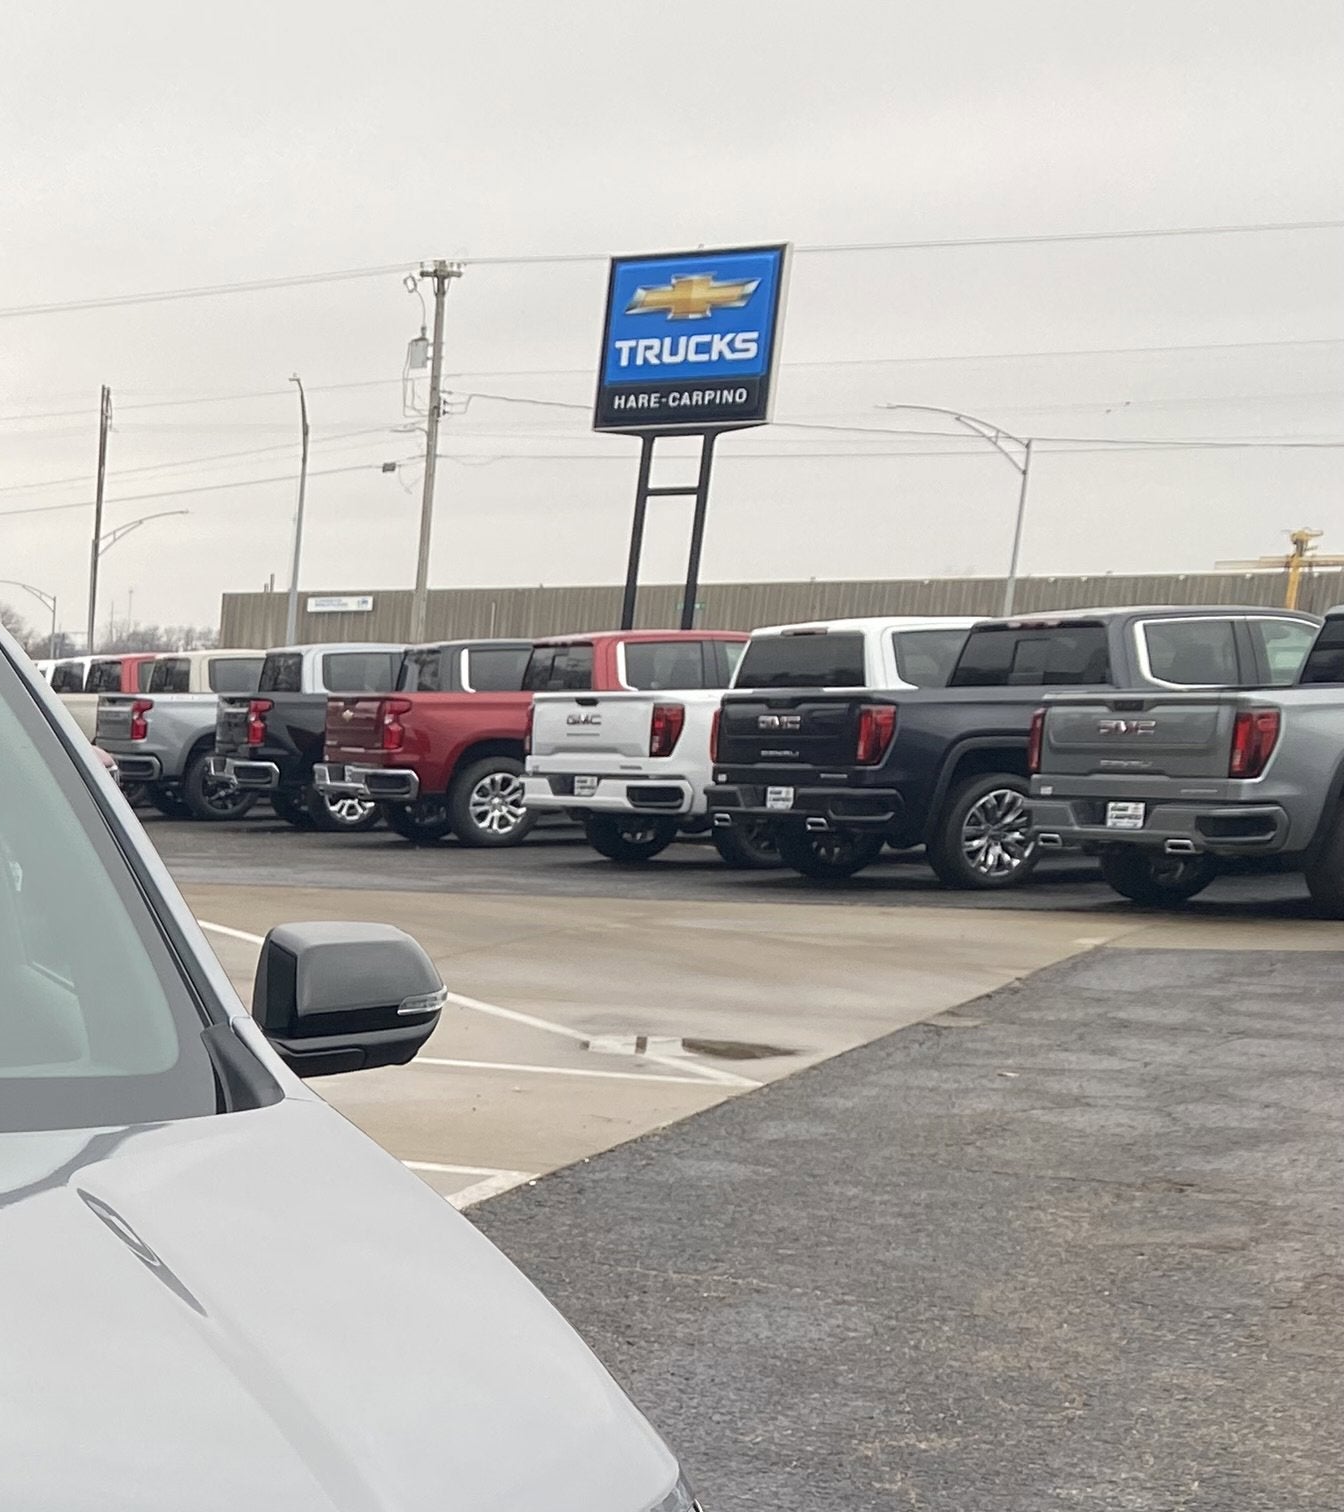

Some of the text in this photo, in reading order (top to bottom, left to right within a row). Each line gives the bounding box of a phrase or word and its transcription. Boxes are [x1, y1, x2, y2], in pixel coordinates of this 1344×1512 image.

[614, 331, 760, 368] TRUCKS
[613, 387, 748, 410] HARE-CARPINO
[566, 713, 602, 726] GMC
